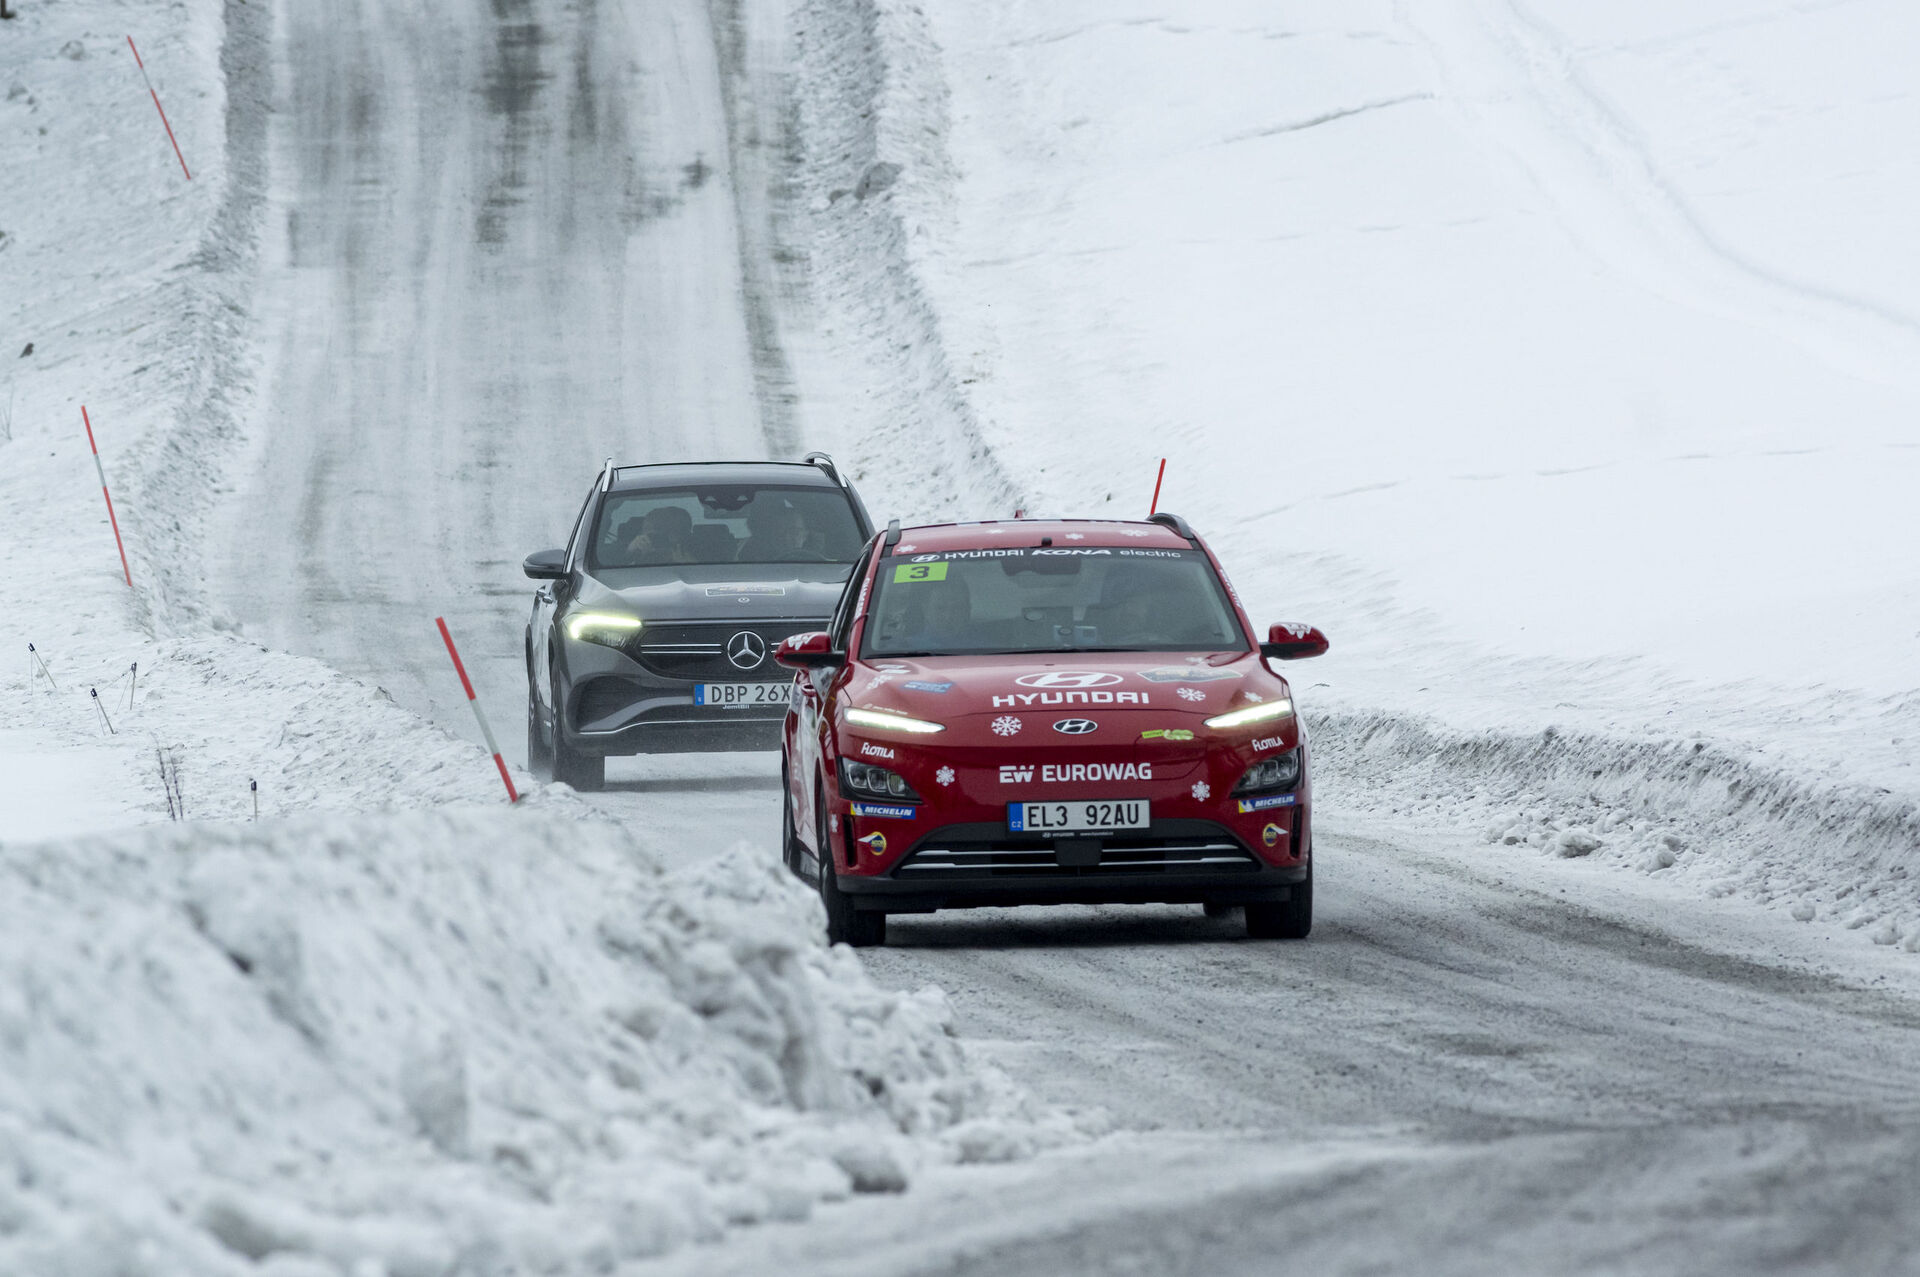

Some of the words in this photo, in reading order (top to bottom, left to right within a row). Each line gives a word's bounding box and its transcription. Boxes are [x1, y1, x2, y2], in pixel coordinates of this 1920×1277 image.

[944, 549, 1024, 560] HYUNDAI
[1119, 549, 1182, 558] electric
[909, 565, 931, 579] 3
[711, 685, 748, 703] DBP
[754, 684, 792, 702] 26X
[992, 690, 1150, 708] HYUNDAI
[860, 742, 895, 759] FLOTILA
[1042, 762, 1153, 783] EUROWAG
[864, 805, 913, 816] MICHELIN
[1027, 805, 1068, 828] EL3
[1085, 803, 1140, 827] 92AU
